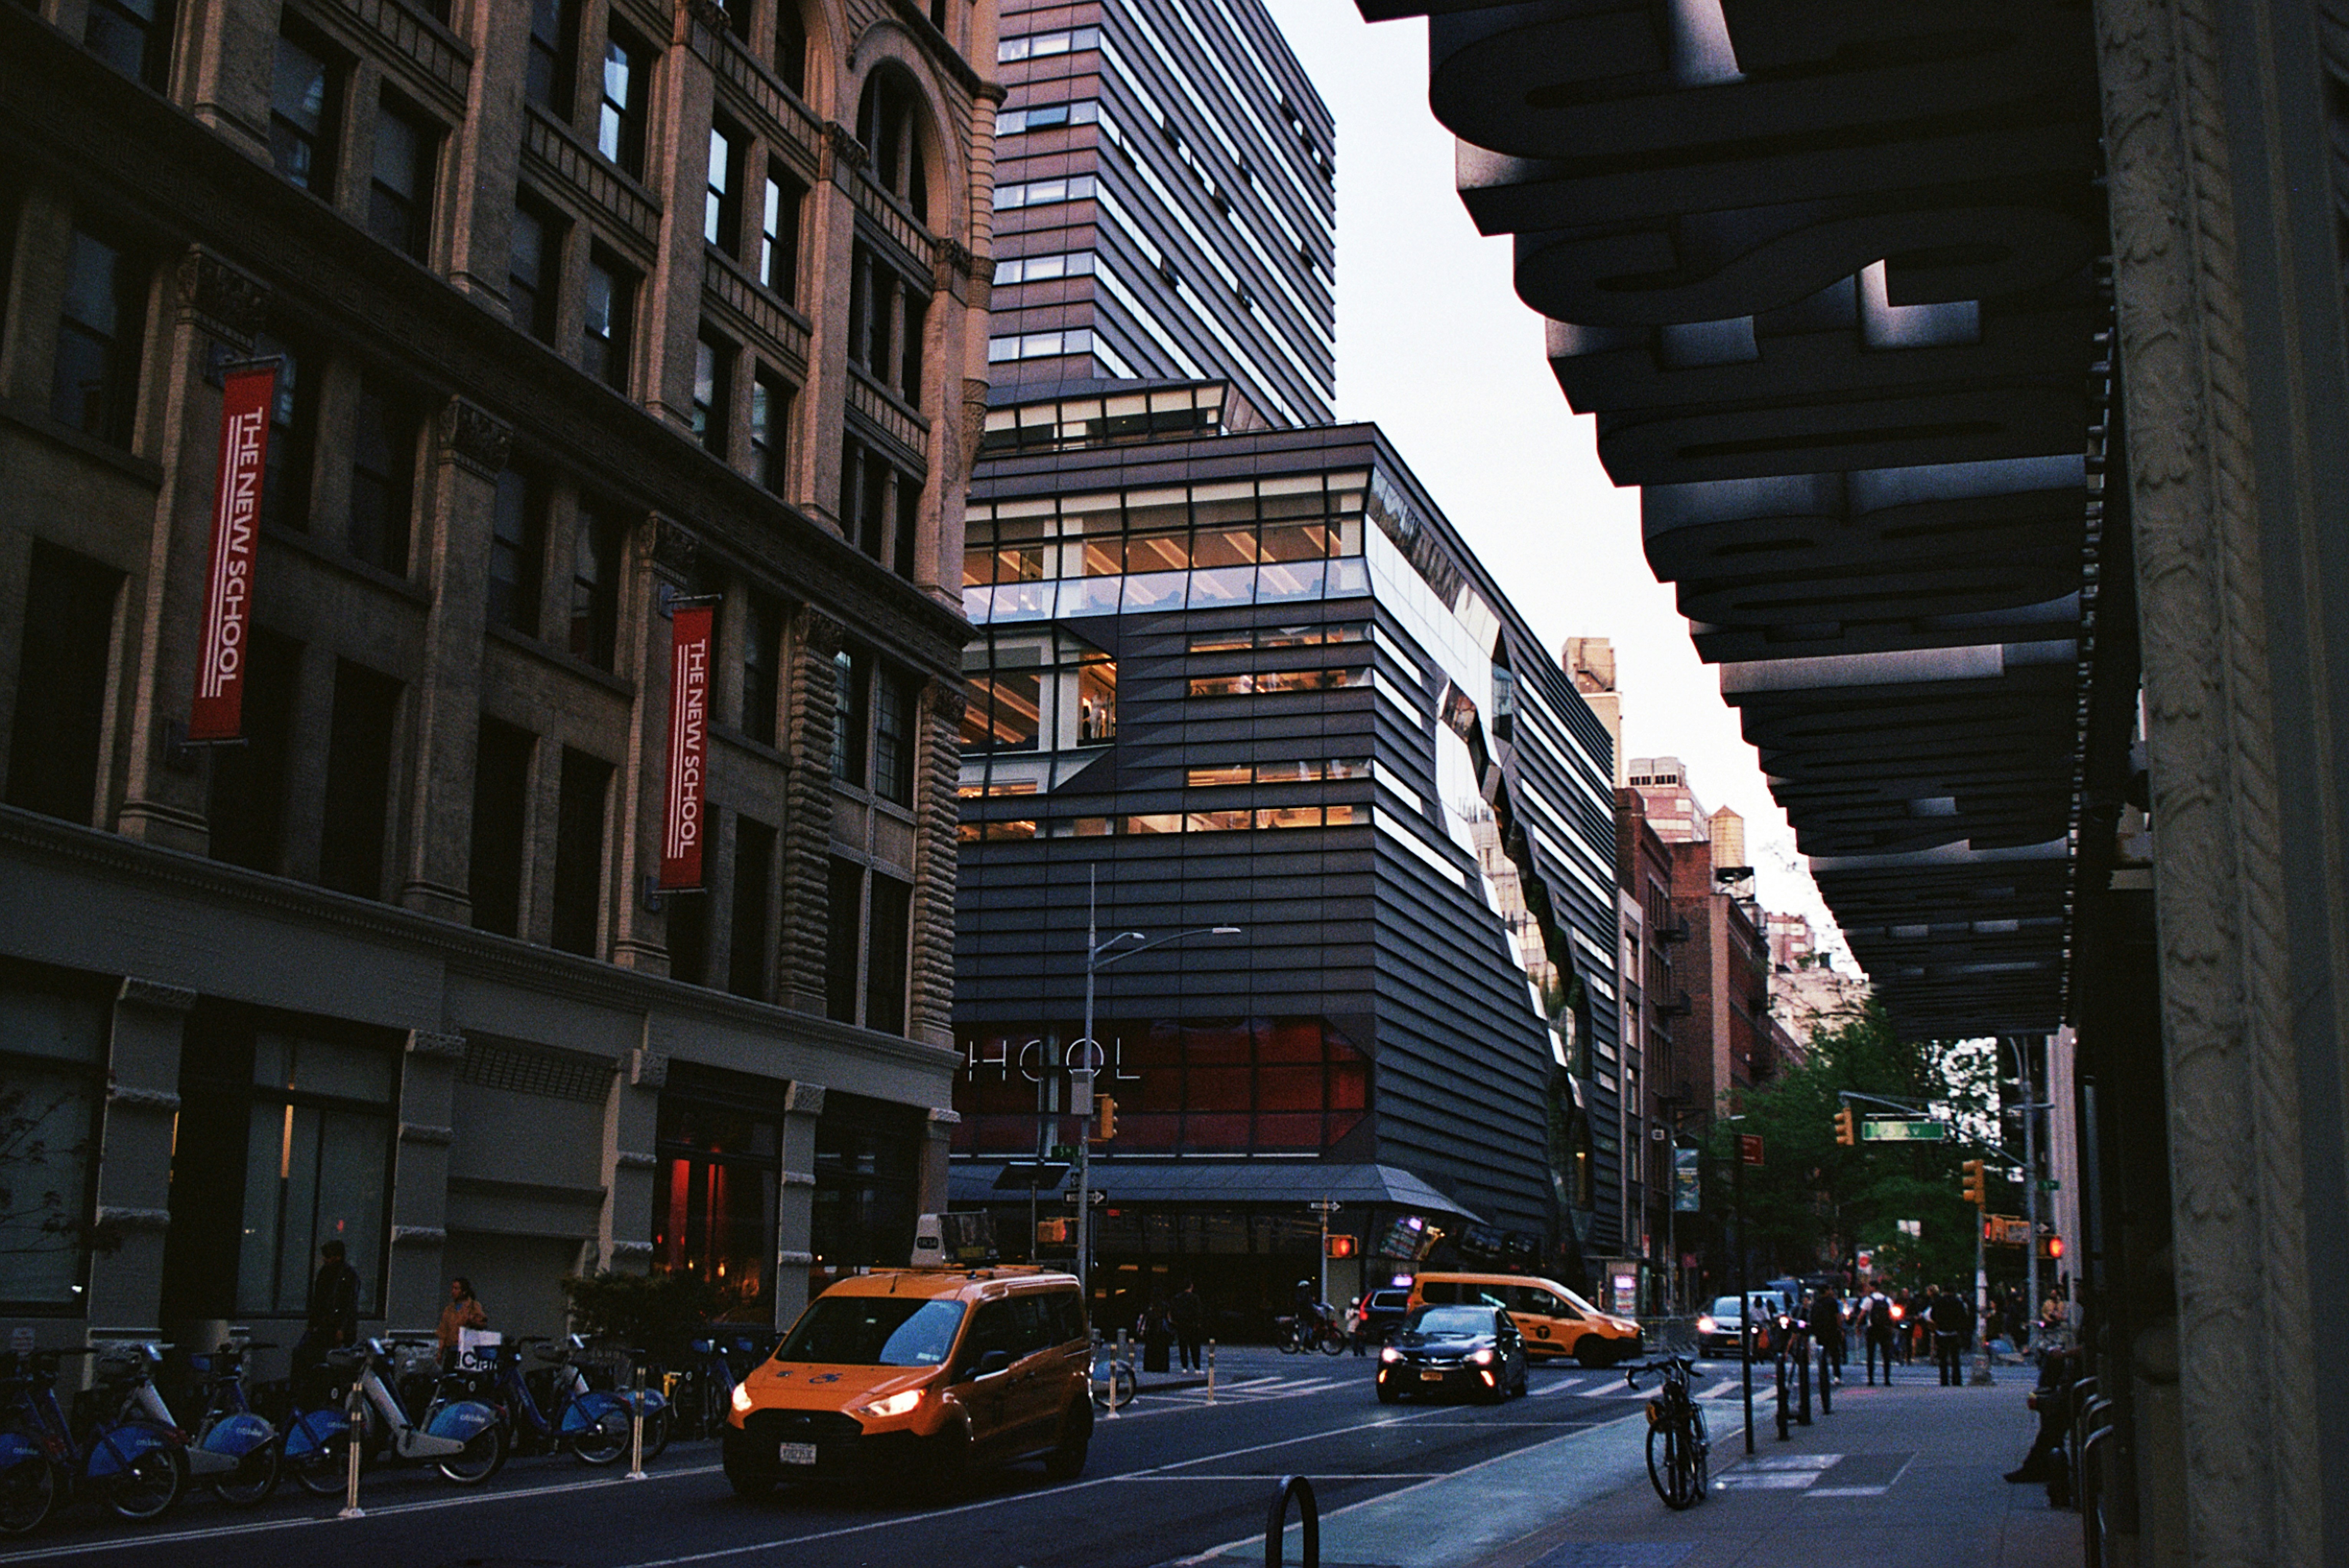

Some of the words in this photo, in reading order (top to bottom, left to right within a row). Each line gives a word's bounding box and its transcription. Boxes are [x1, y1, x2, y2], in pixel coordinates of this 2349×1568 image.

[239, 406, 263, 466] THE
[230, 473, 255, 554] NEW
[216, 559, 247, 697] SCHOOL
[689, 639, 705, 684] THE
[686, 689, 703, 751] NEW
[679, 756, 699, 858] SCHOOL
